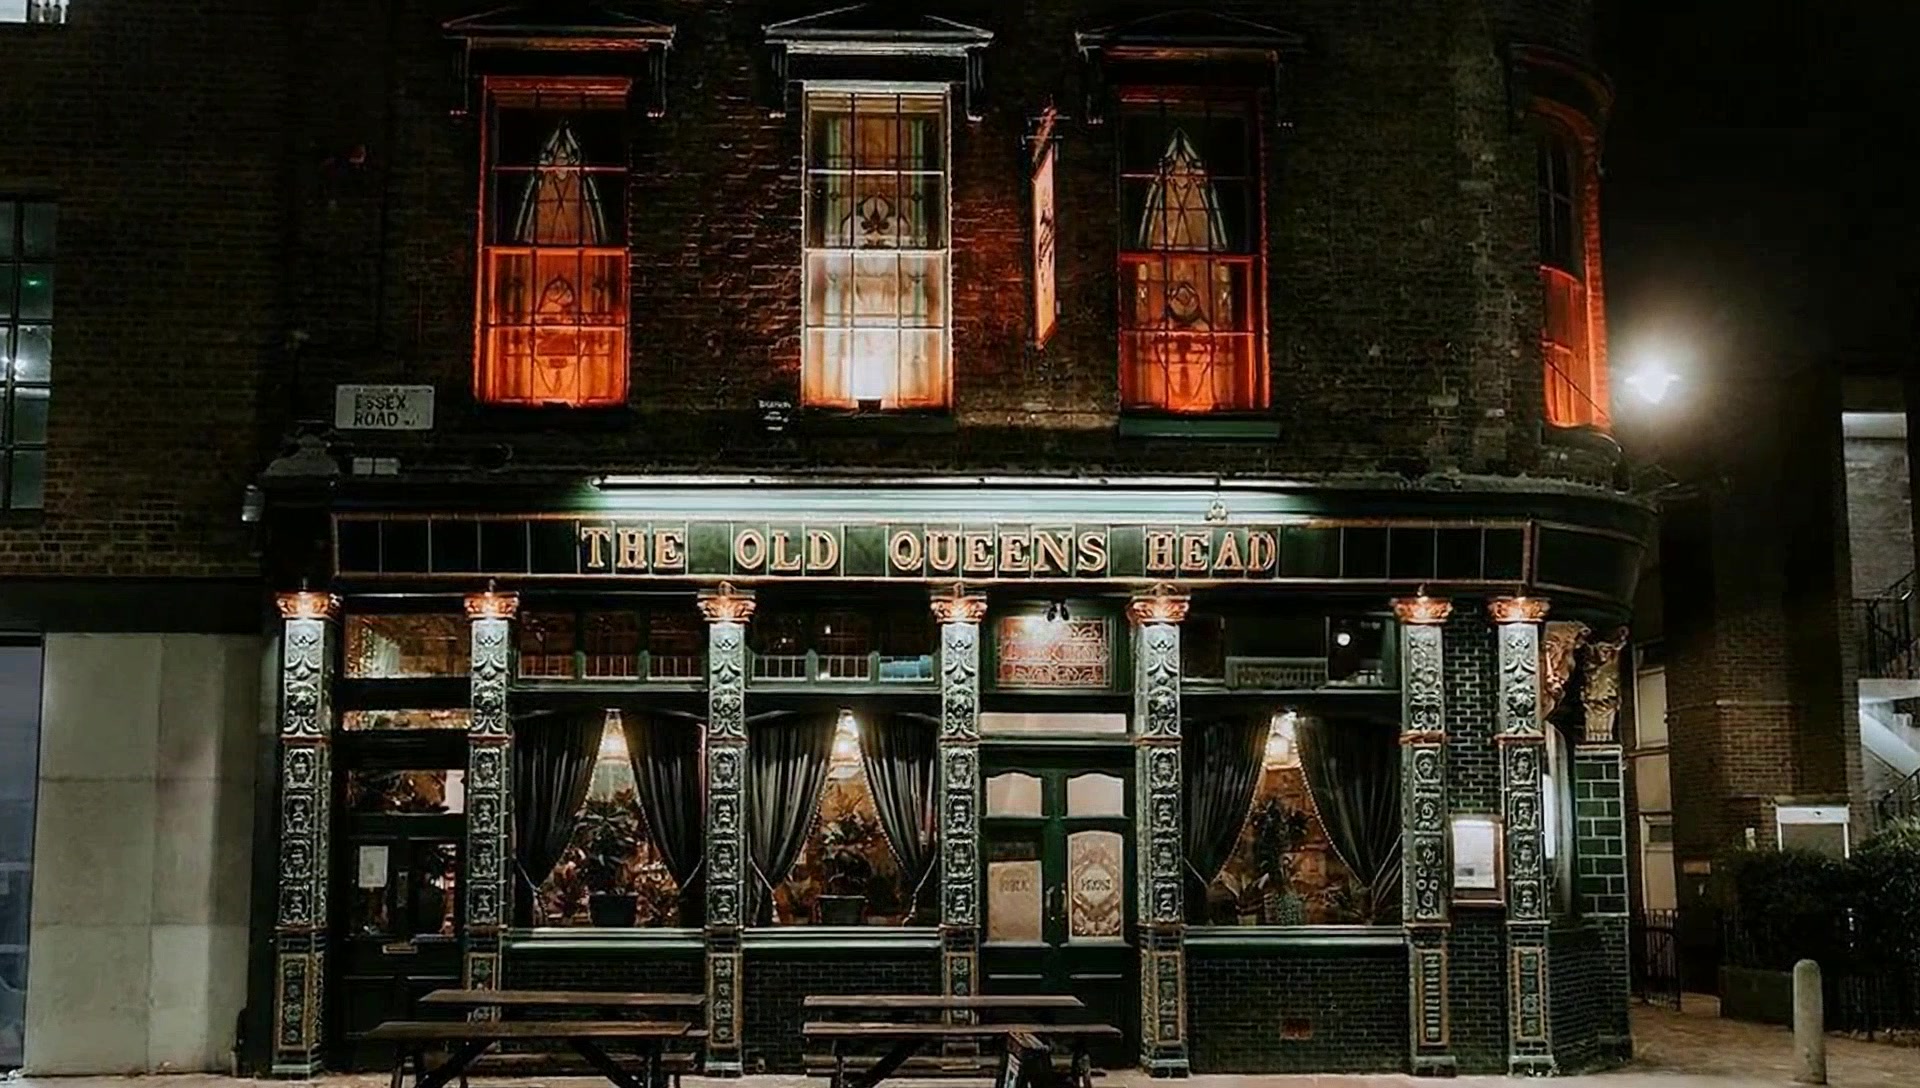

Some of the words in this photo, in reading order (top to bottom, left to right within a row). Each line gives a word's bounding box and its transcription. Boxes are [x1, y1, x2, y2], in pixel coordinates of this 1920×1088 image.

[355, 394, 406, 410] ESSEX
[354, 412, 398, 426] ROAD
[581, 527, 685, 568] THE
[733, 528, 838, 571] OLD
[888, 530, 1107, 572] QUEENS
[1146, 531, 1277, 572] HEAD
